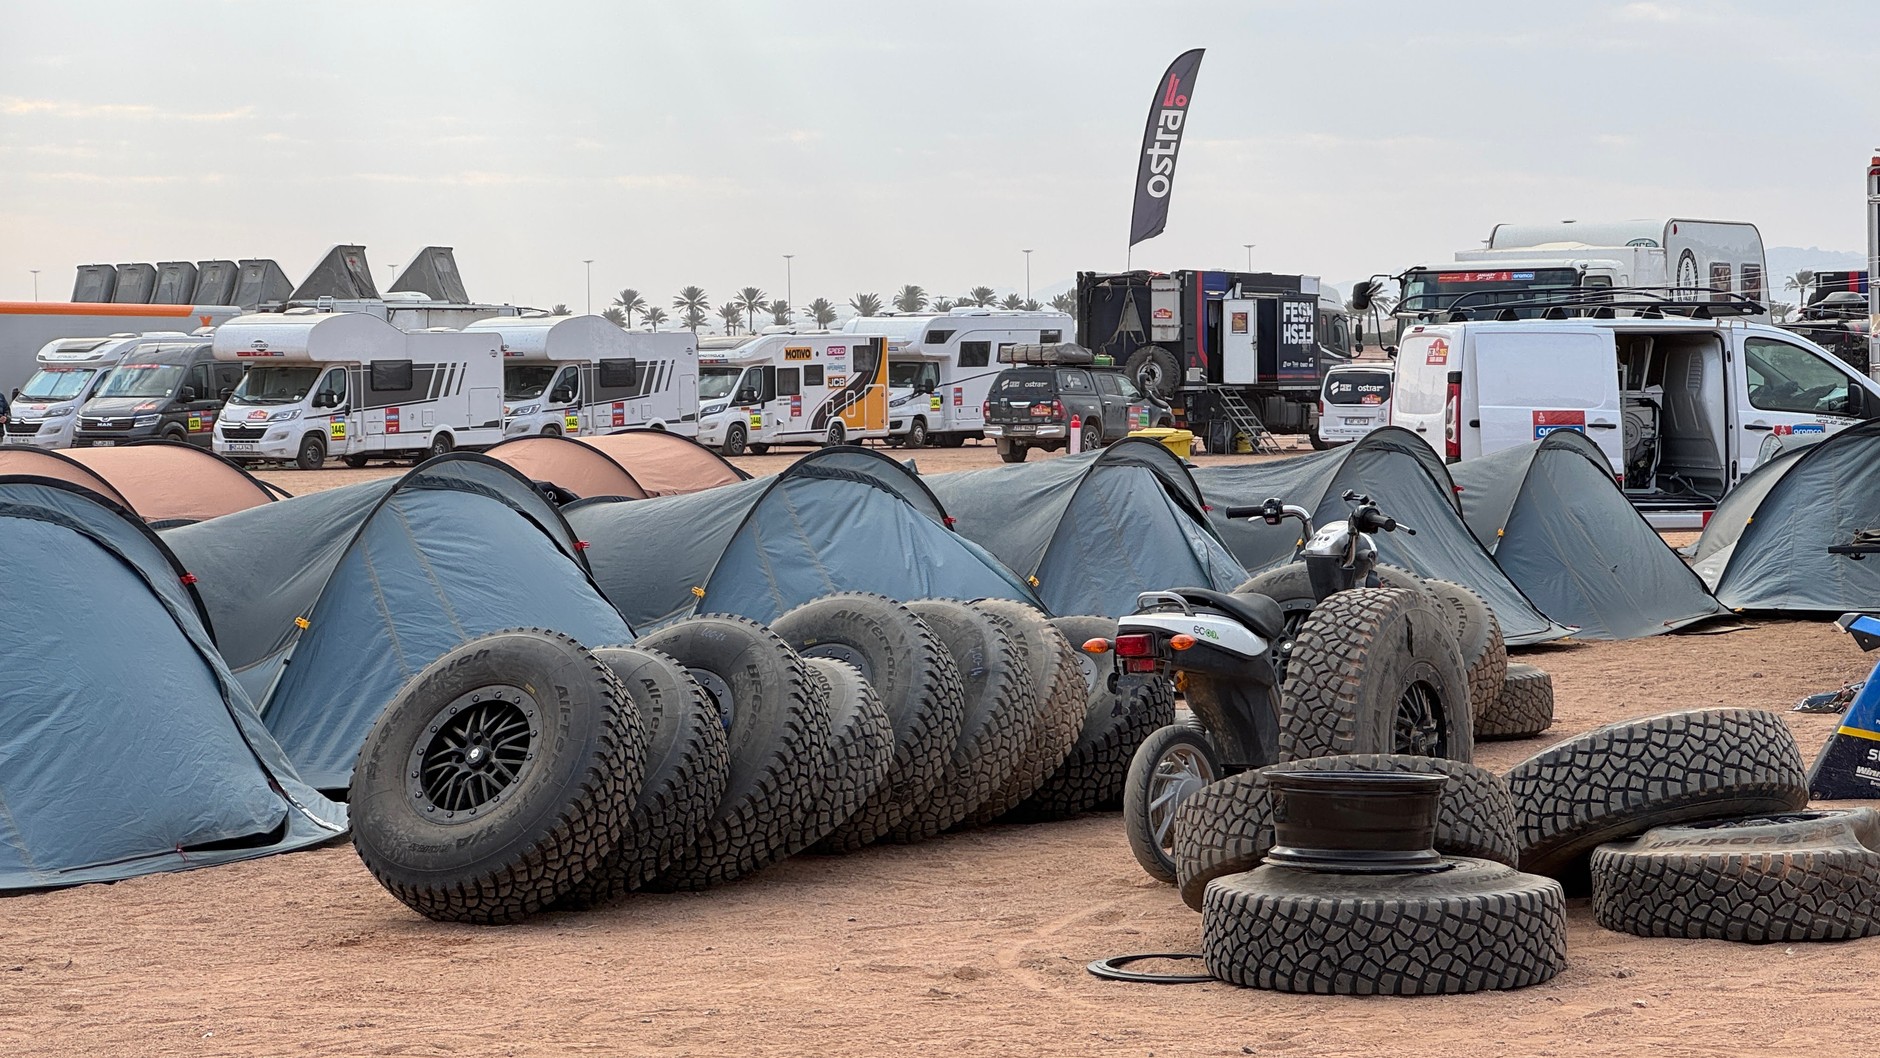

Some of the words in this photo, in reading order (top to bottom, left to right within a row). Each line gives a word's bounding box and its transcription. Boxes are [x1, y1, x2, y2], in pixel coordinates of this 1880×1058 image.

[1283, 302, 1314, 323] FESH
[785, 349, 811, 359] MOTIVO
[828, 378, 845, 387] JCB
[566, 418, 578, 427] 1445
[332, 424, 345, 434] 1443
[831, 609, 896, 692] All-Terrain
[1650, 823, 1846, 850] BFGoodrich
